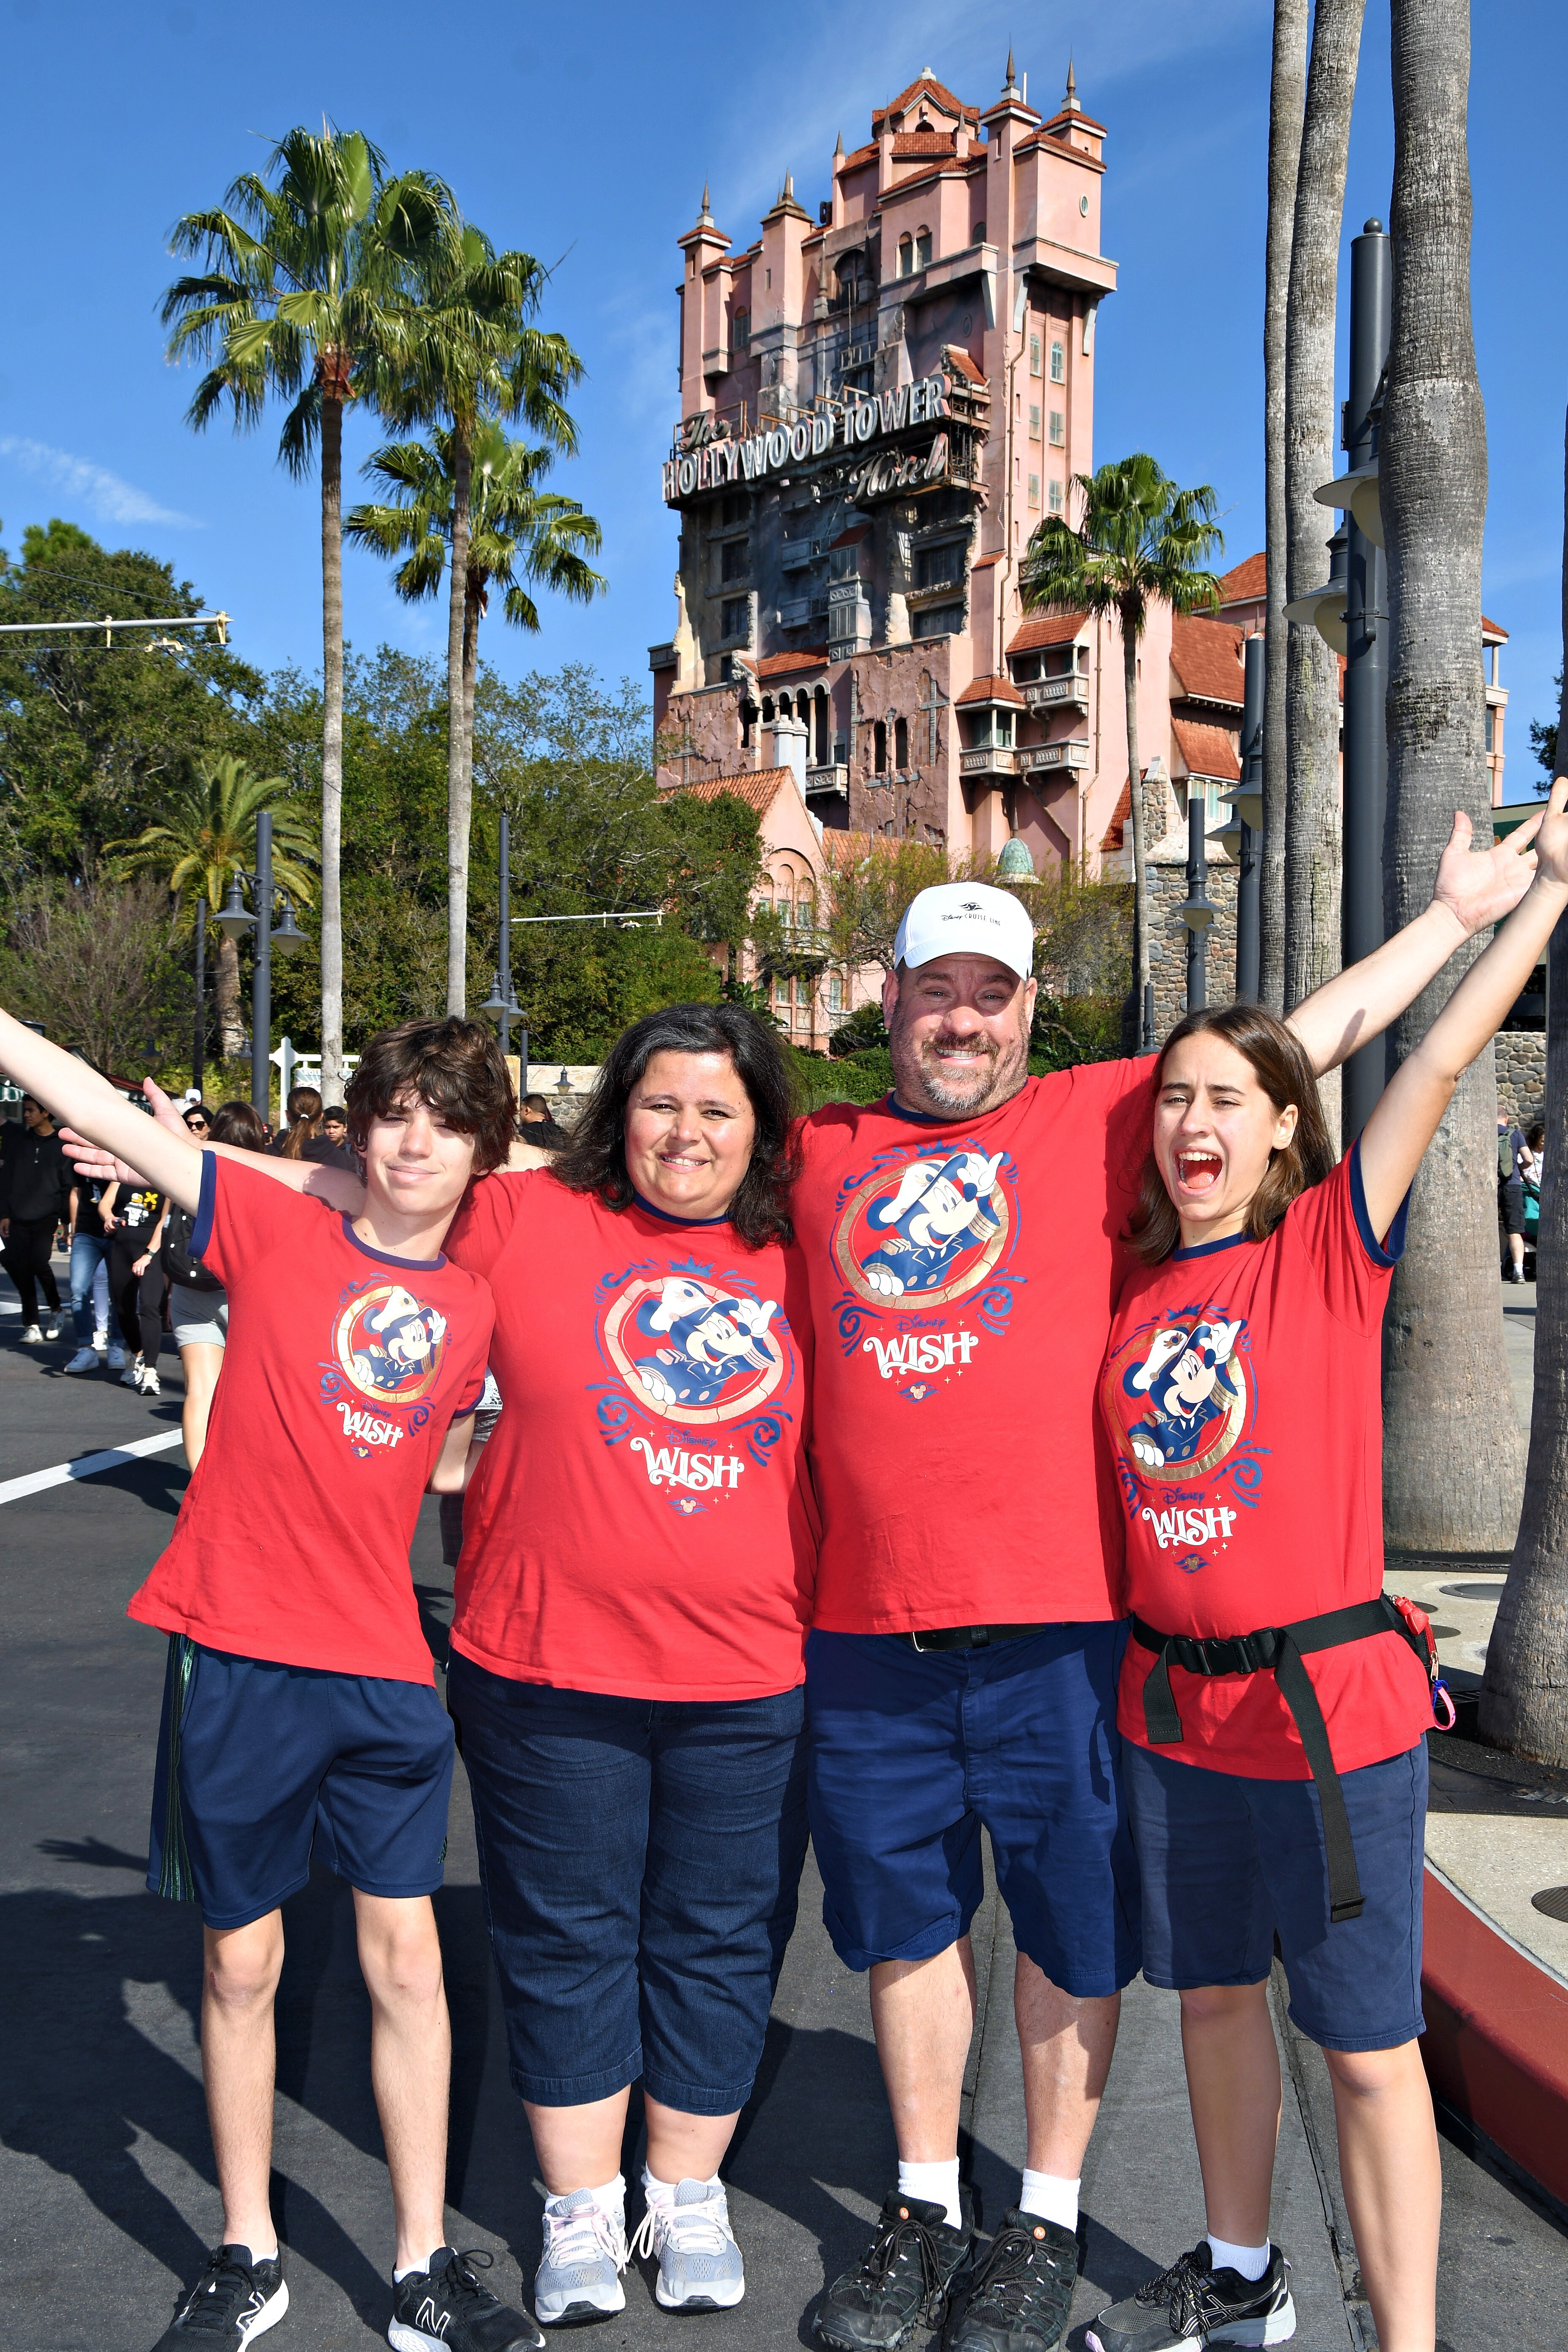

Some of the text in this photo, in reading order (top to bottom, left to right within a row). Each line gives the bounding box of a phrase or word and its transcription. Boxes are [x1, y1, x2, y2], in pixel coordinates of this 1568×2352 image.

[662, 374, 952, 502] HOLLYWOOD TOWER
[675, 409, 732, 454] The
[845, 432, 947, 504] Hotel
[990, 917, 1001, 926] LINE
[863, 1331, 979, 1379] WISH
[336, 1402, 404, 1448] WISH
[630, 1437, 745, 1491] WISH
[1142, 1506, 1237, 1549] WISH
